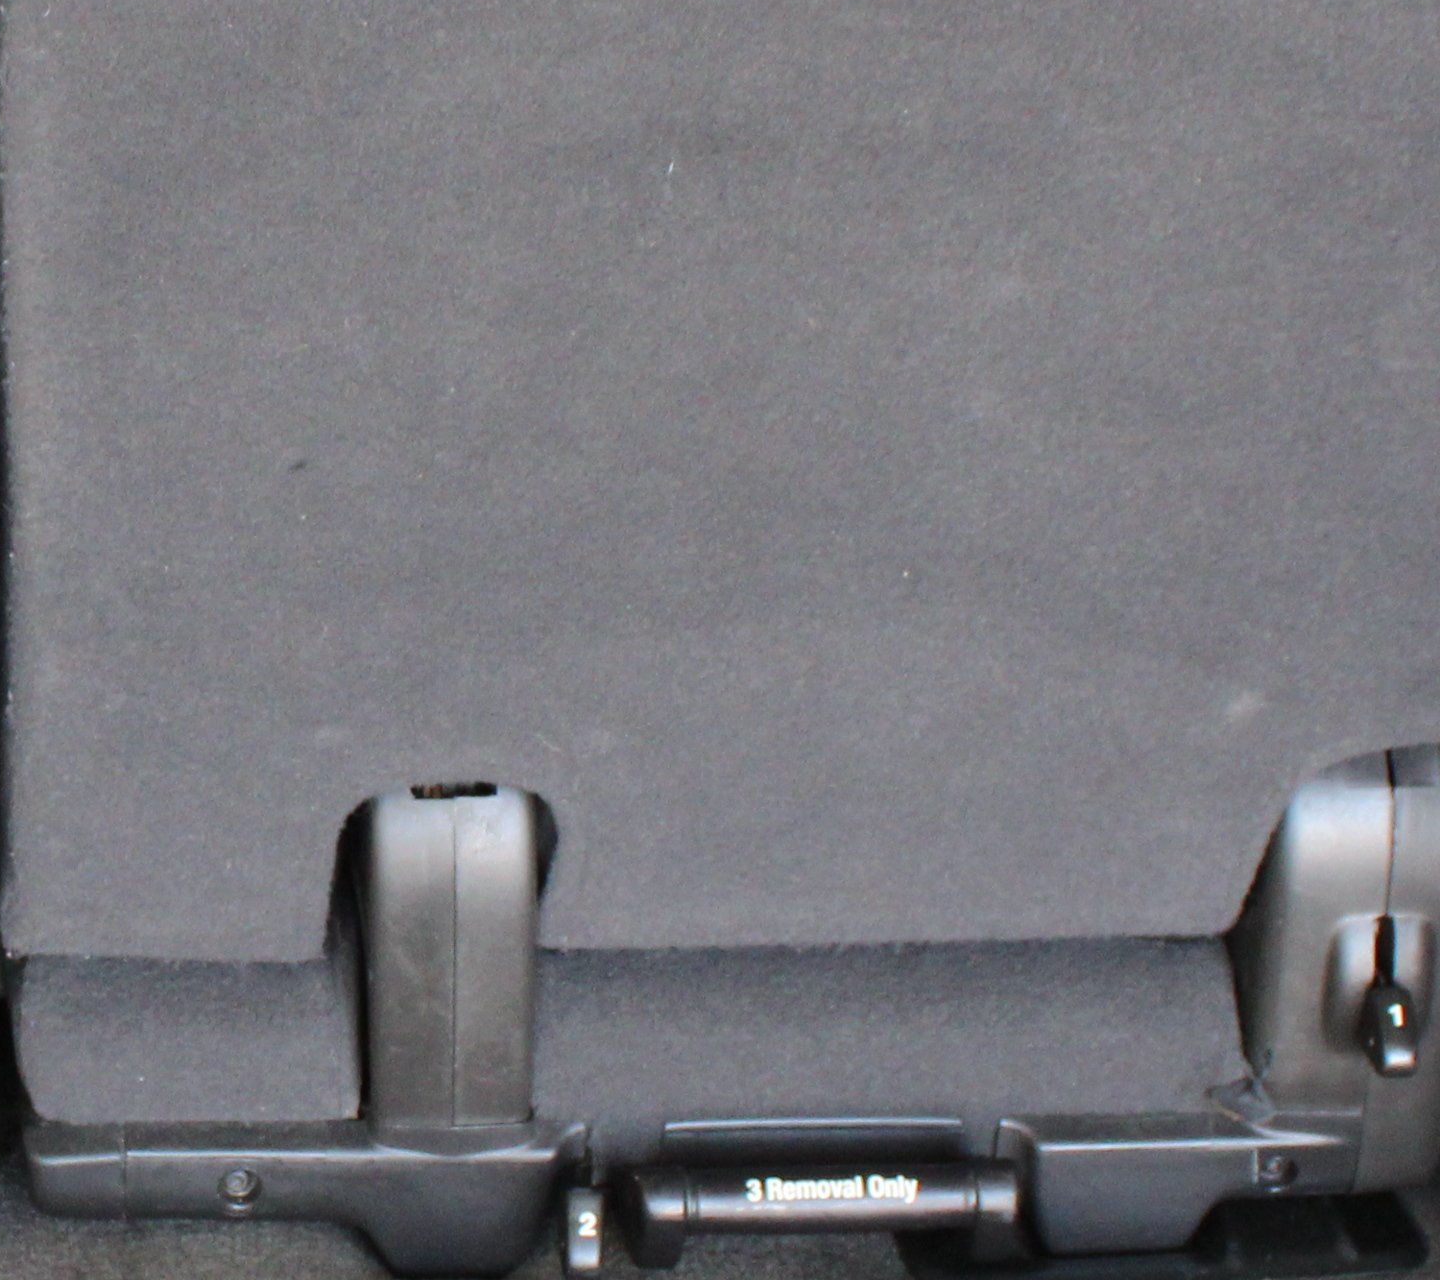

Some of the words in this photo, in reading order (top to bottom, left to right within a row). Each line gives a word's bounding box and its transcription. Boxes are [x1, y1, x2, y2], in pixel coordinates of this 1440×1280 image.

[1387, 1003, 1407, 1028] 1
[745, 1177, 763, 1203] 3
[765, 1175, 866, 1202] Removal
[868, 1174, 920, 1204] Only
[579, 1211, 598, 1236] 2
